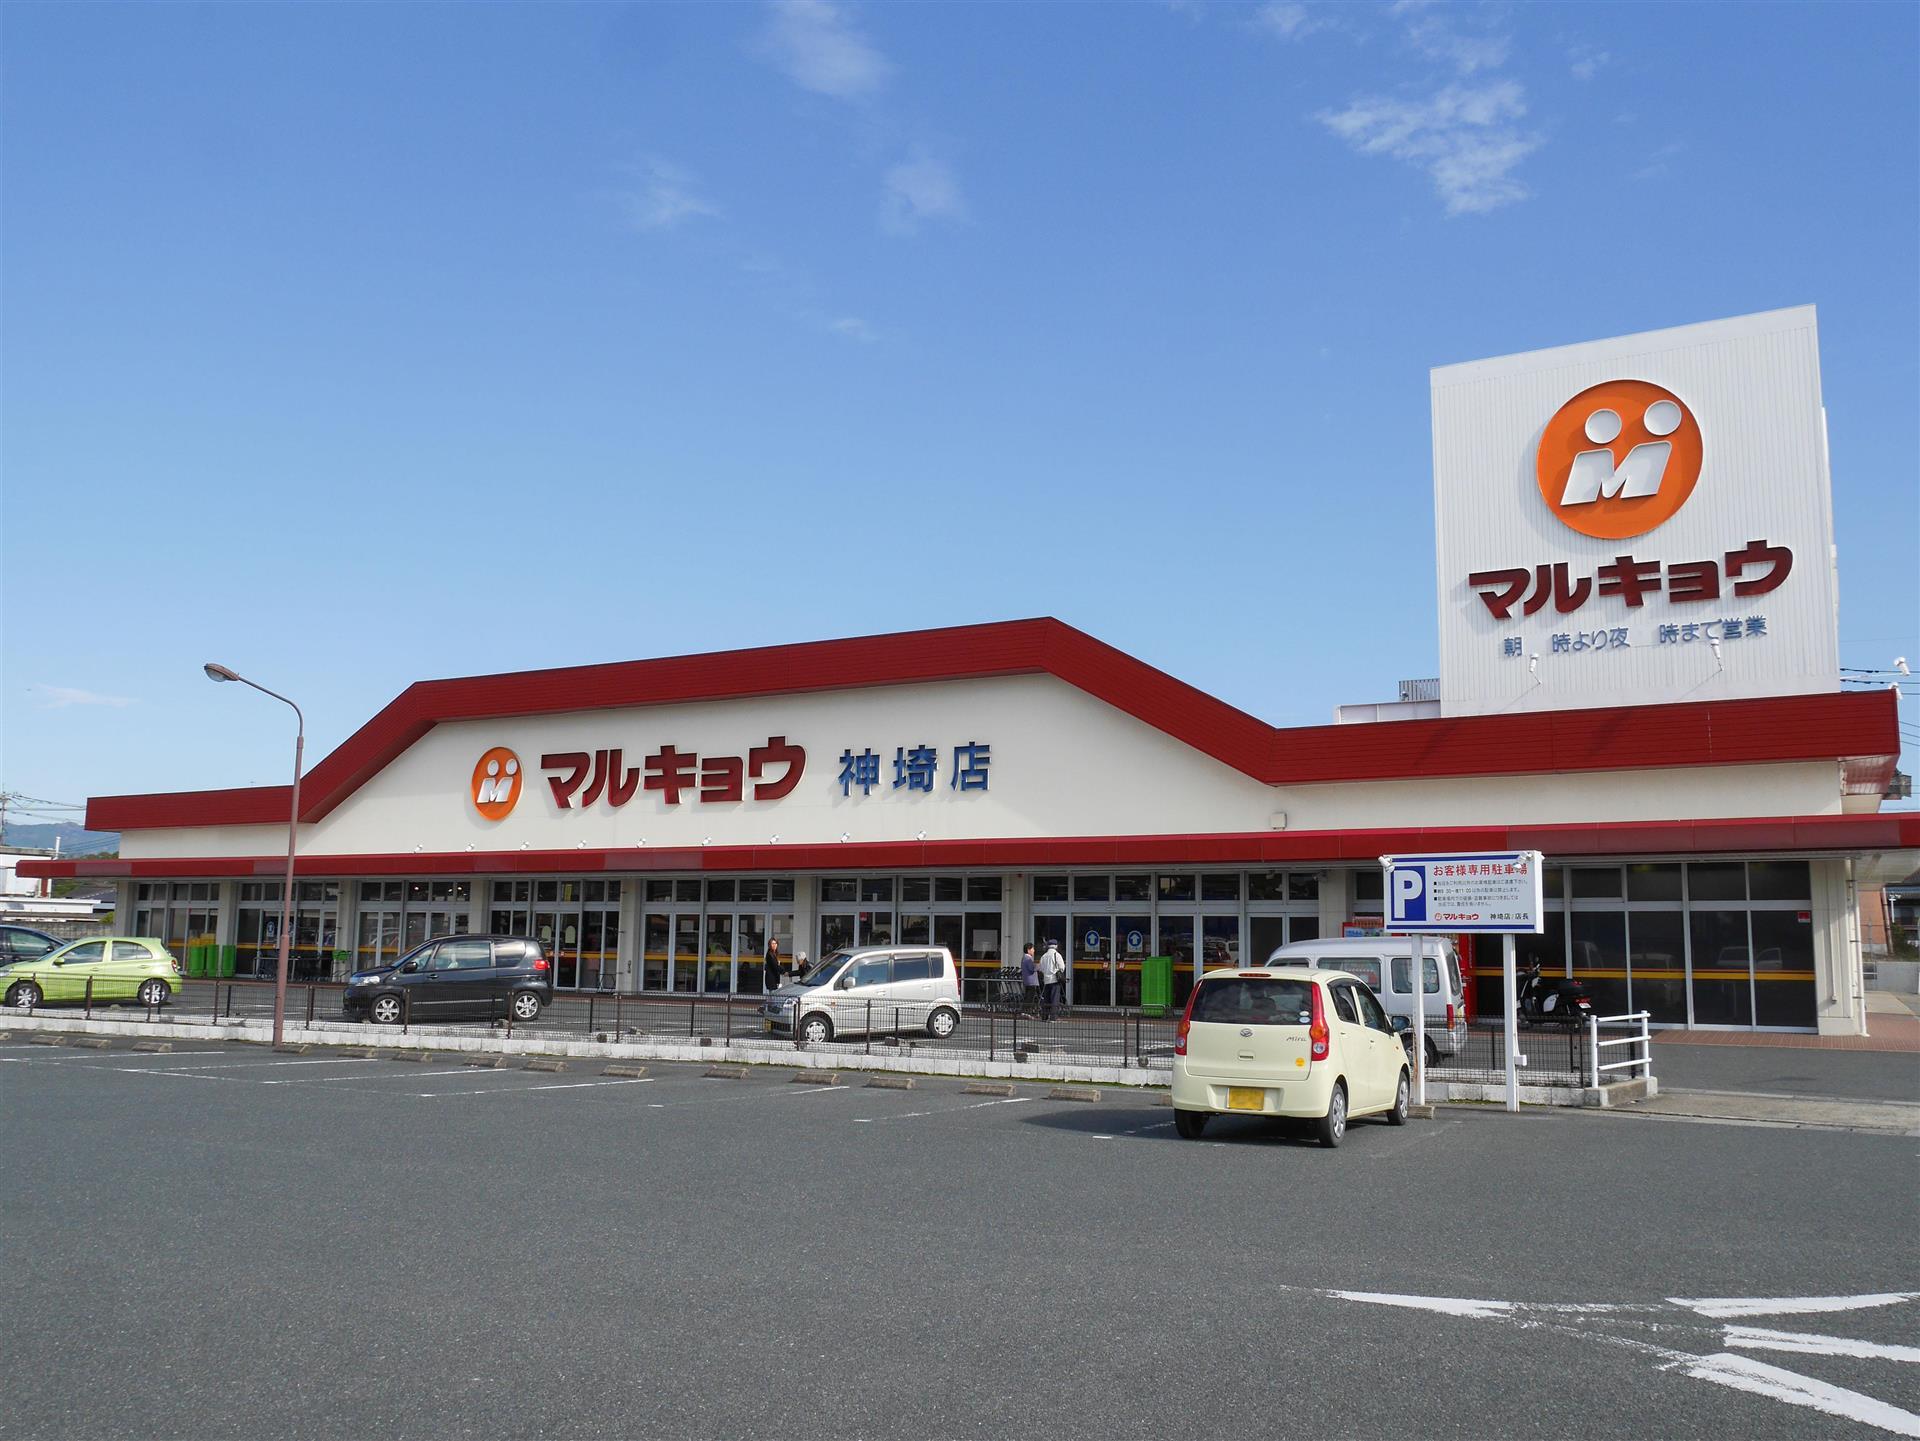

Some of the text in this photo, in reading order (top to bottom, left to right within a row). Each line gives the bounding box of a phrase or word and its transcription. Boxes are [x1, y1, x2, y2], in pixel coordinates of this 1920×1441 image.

[1468, 538, 1793, 621] マルキョウ
[1503, 637, 1523, 657] 朝
[1551, 627, 1631, 653] 時より夜
[540, 736, 992, 810] マルキョウ 神埼店
[1393, 869, 1423, 919] P
[1442, 912, 1480, 921] マルキョウ
